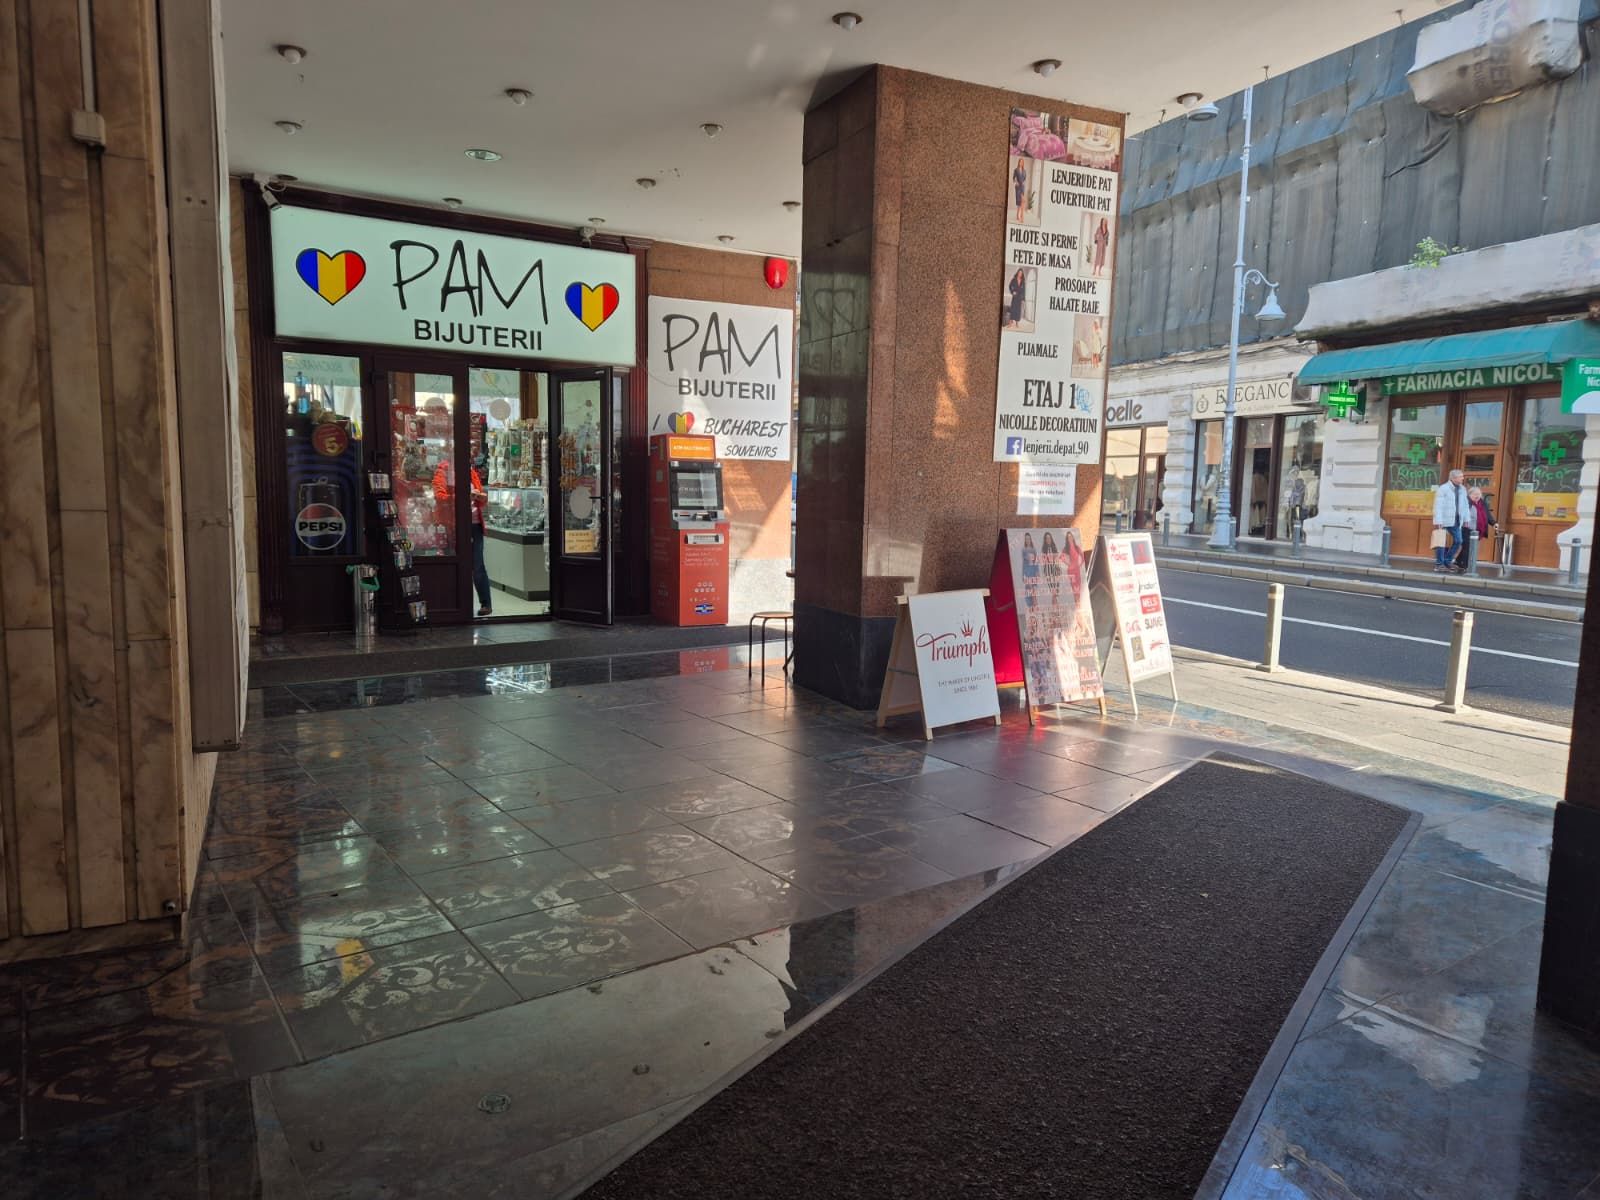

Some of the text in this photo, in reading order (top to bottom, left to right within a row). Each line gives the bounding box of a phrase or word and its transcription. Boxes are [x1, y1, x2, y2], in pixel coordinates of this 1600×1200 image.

[1098, 177, 1113, 192] PAT
[1050, 189, 1112, 212] CUVERTURI PAT
[1009, 228, 1079, 250] PILOTE SI PERNE
[1013, 249, 1072, 270] FETE DE MASA
[389, 239, 549, 325] PAM
[1055, 277, 1097, 295] PROSOAPE
[1049, 296, 1100, 315] HALATE BAIE
[414, 318, 542, 351] BIJUTERII
[662, 311, 782, 380] PAM
[1017, 341, 1059, 359] PIJAMALE
[1396, 363, 1554, 392] FARMACIA NICOL
[678, 378, 776, 401] BIJUTERII
[1022, 378, 1065, 409] ETAJ
[1068, 383, 1077, 410] 1
[703, 417, 788, 438] BUCHAREST
[998, 413, 1098, 433] NICOLLE DECORATIUNI
[724, 444, 778, 458] SOUVENIRS
[1023, 438, 1089, 457] lenjerii.depat.90
[298, 521, 343, 532] PEPSI
[915, 625, 989, 668] Triumph
